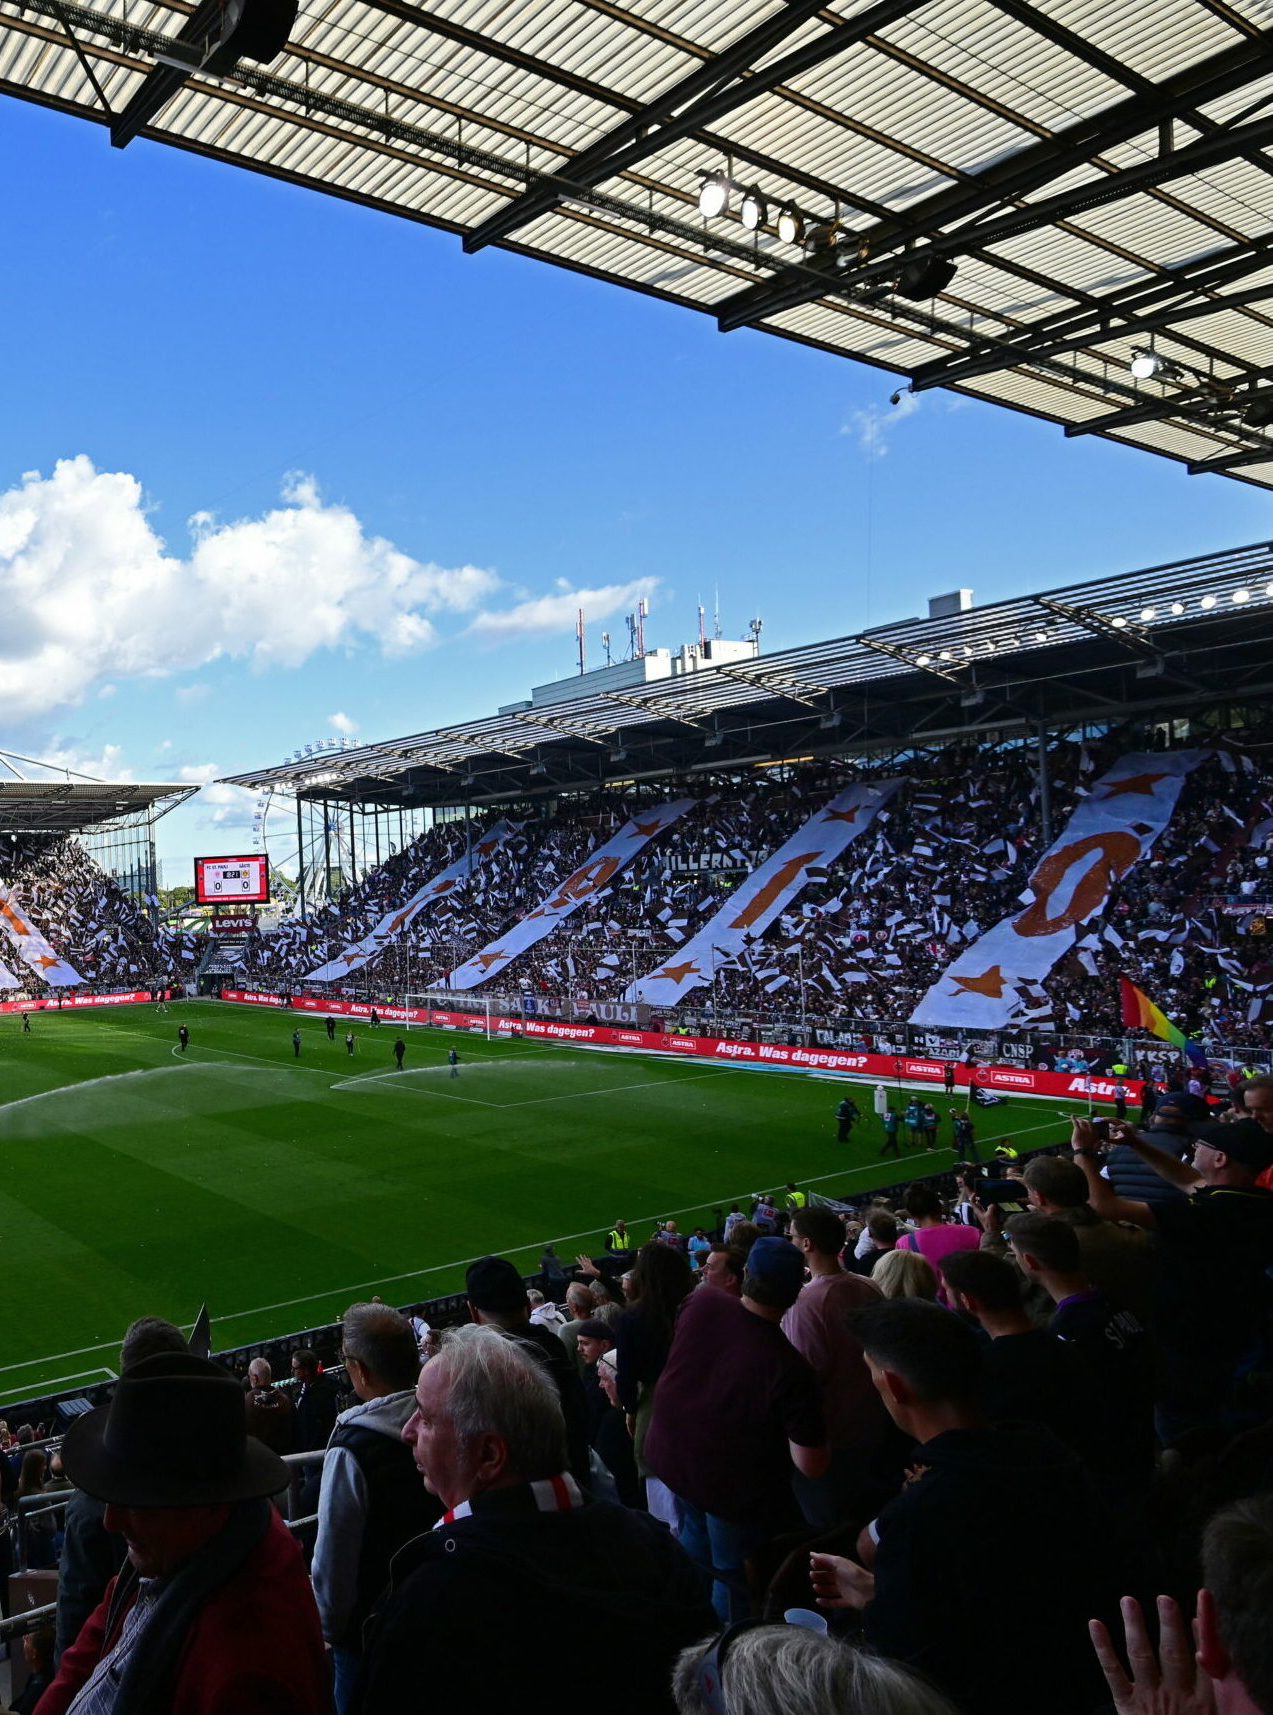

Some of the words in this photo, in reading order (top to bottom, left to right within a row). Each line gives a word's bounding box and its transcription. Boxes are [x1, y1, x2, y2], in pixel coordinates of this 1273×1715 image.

[46, 998, 72, 1007] Asra.
[75, 996, 93, 1005] Was
[94, 993, 135, 1004] dagegen?
[350, 1004, 369, 1013] Astra.
[498, 1019, 523, 1031] Astra.
[526, 1021, 546, 1033] Was
[547, 1024, 595, 1038] dagegen?
[620, 1034, 641, 1042] ASTRA
[672, 1039, 694, 1048] ASTRA
[715, 1041, 755, 1057] Astra.
[758, 1045, 789, 1060] Was
[792, 1048, 868, 1069] dagegen?
[1002, 1043, 1034, 1059] CNSP
[909, 1064, 942, 1075] ASTRA
[993, 1073, 1031, 1085] ASTRA
